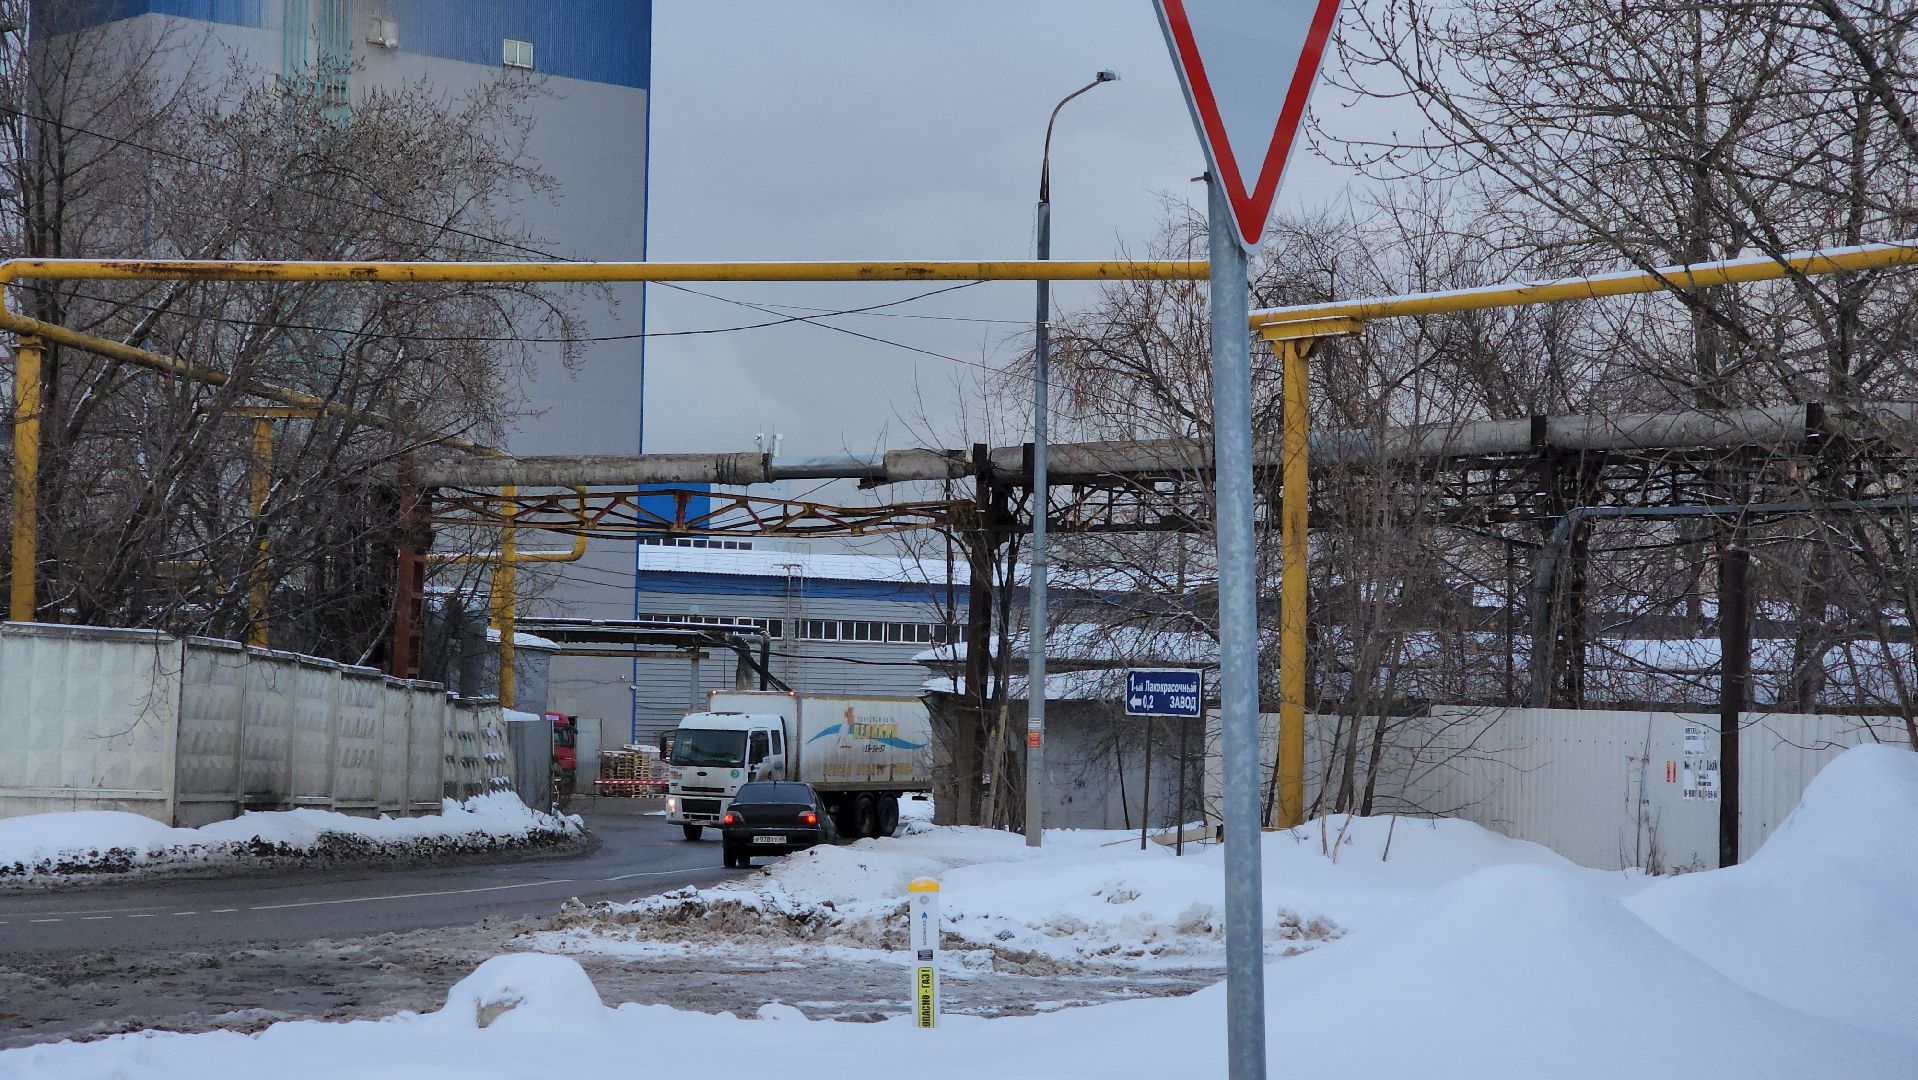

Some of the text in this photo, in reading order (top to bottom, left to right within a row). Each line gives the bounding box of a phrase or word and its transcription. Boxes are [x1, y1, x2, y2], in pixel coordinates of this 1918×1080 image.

[1145, 680, 1197, 695] Лакокрасочный
[1142, 694, 1197, 712] 0,2 ЗАВОД
[922, 994, 931, 1028] ОПАСНО
